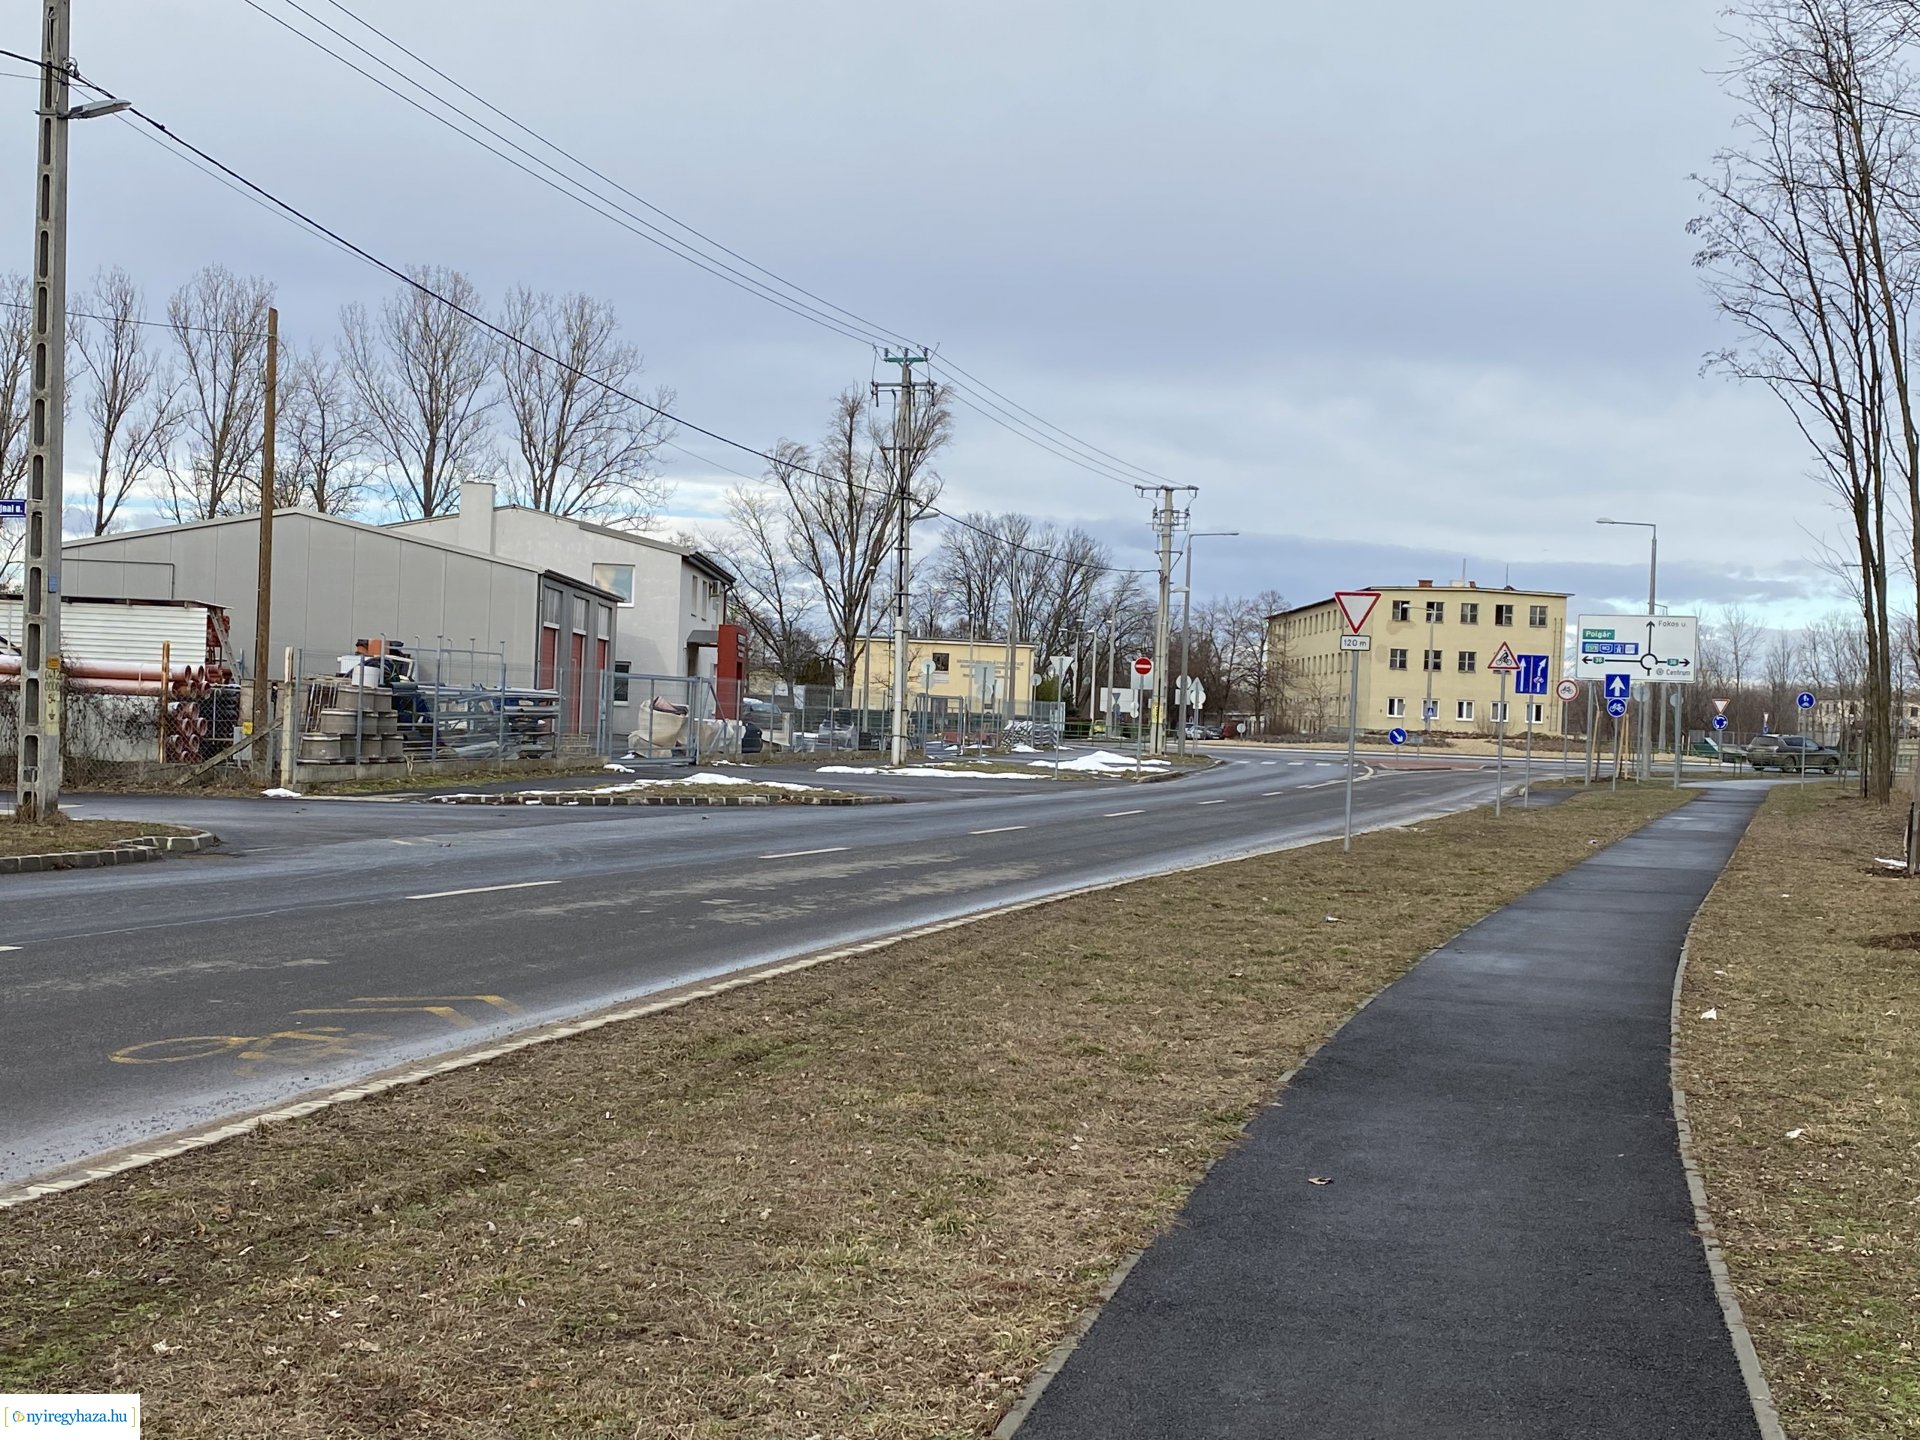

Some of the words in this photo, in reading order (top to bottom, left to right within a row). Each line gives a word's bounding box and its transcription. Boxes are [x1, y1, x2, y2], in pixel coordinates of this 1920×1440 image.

[15, 505, 23, 513] u.
[1586, 630, 1612, 638] Polgár
[1343, 639, 1358, 647] 120
[1666, 668, 1691, 676] Centrum
